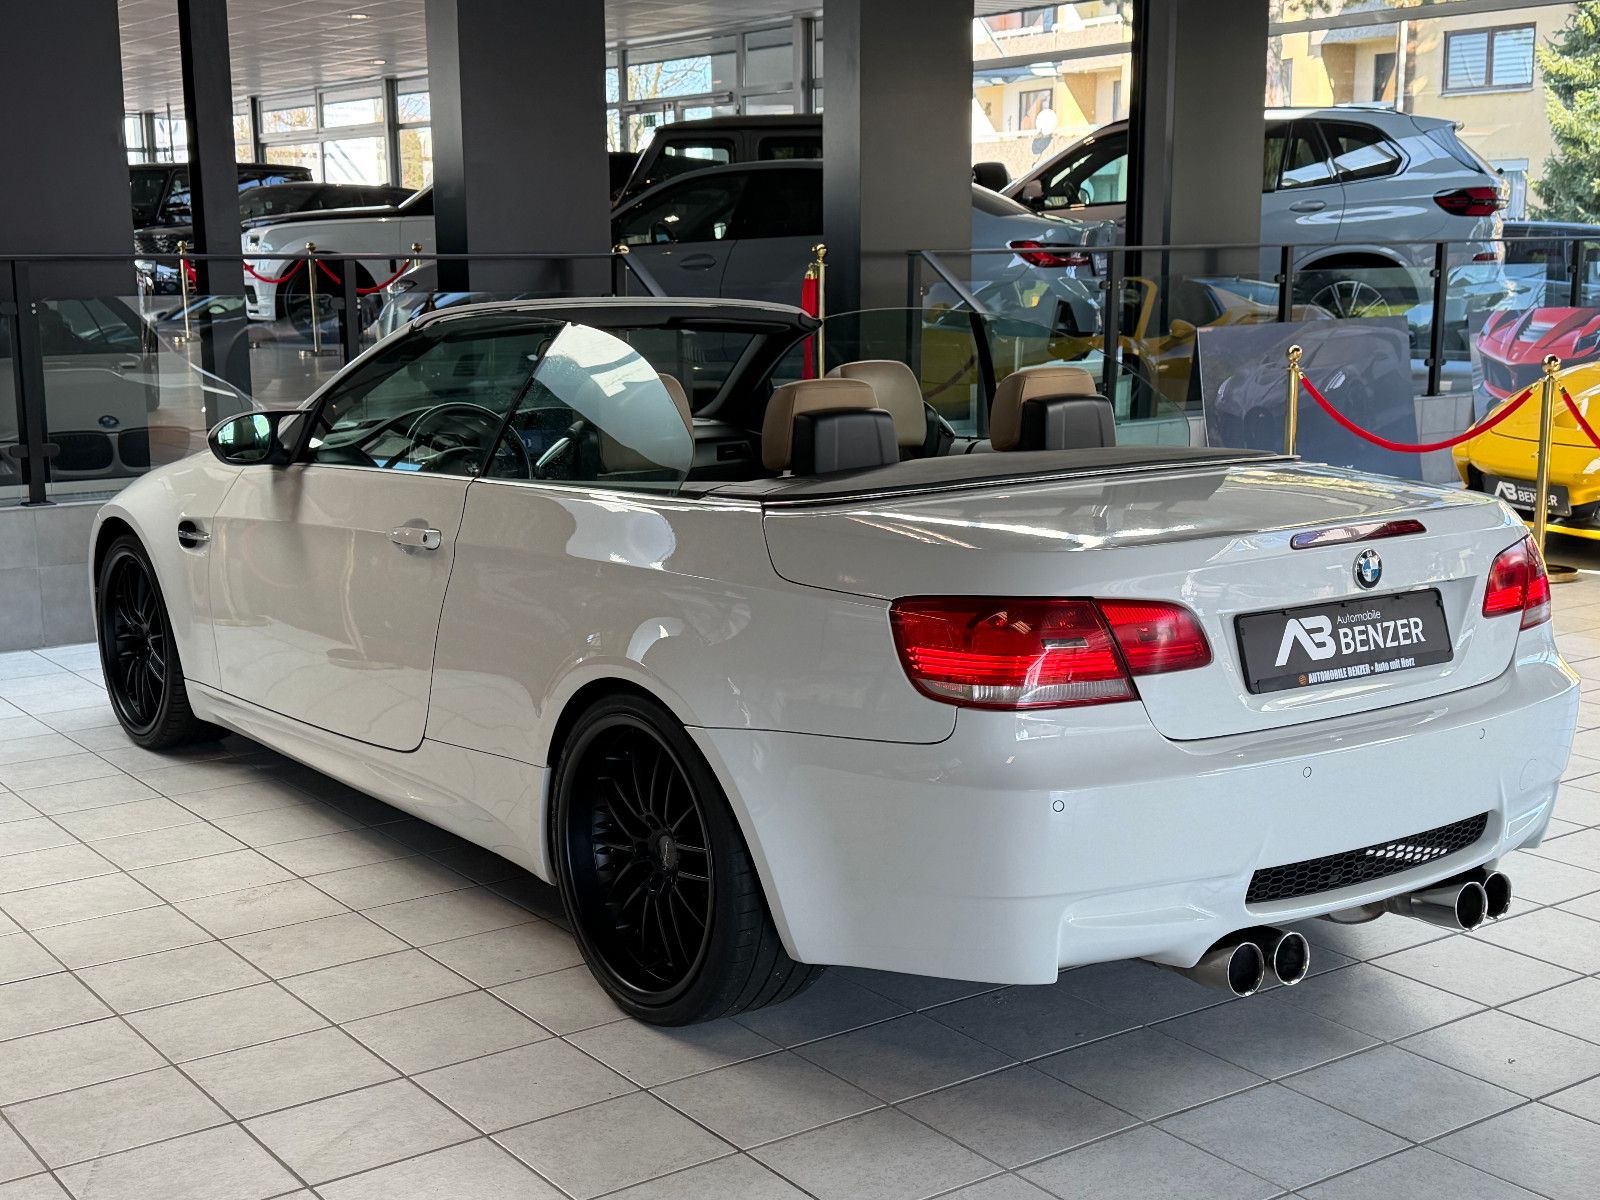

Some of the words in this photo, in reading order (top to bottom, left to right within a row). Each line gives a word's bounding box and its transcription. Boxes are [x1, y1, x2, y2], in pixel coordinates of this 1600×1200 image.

[1517, 490, 1559, 507] BENR
[1336, 609, 1381, 625] Automobile
[1338, 617, 1426, 655] BENZER
[1308, 667, 1347, 684] AUTOMOBILE
[1347, 663, 1371, 678] BENZER
[1374, 661, 1390, 673] Auto
[1389, 659, 1401, 671] mit
[1400, 657, 1416, 669] Herz
